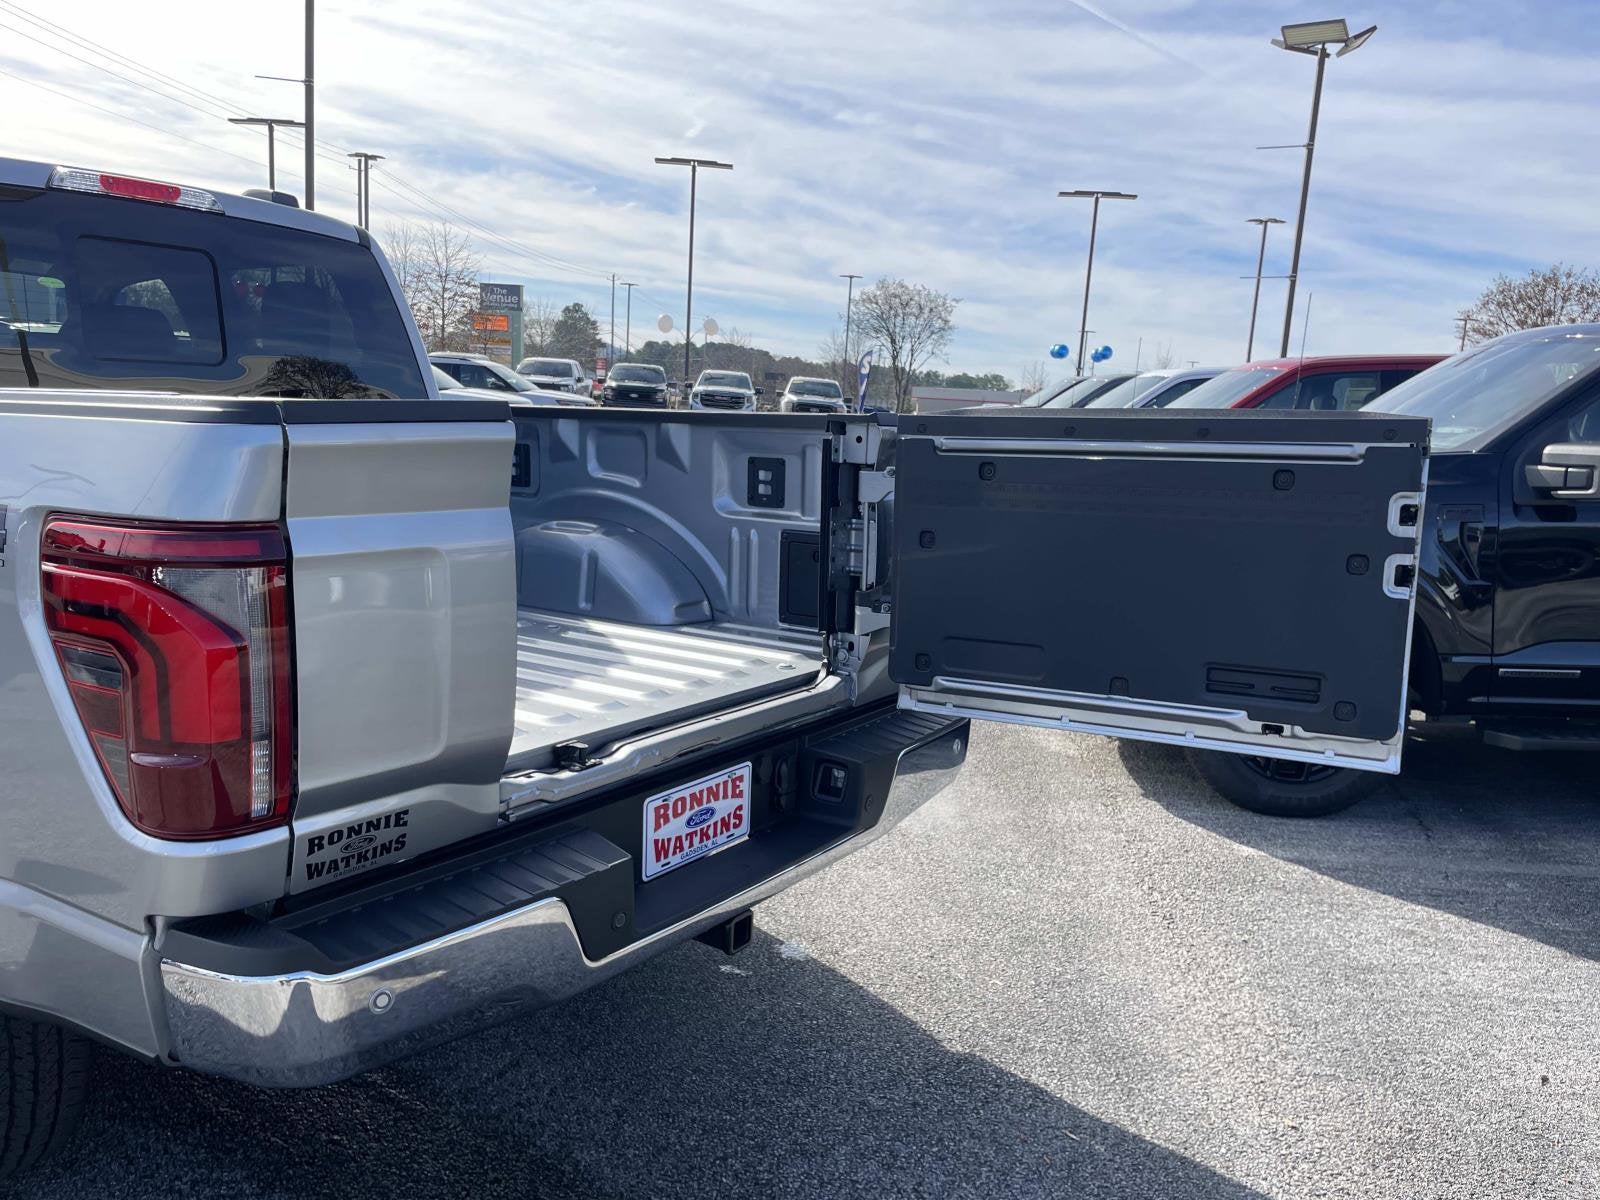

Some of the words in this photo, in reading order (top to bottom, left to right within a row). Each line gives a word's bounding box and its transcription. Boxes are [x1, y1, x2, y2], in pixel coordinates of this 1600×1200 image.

[482, 293, 519, 303] Venue
[493, 287, 508, 295] The
[654, 774, 744, 833] RONNIE
[688, 809, 714, 826] Ford
[306, 833, 406, 880] WATKINS
[307, 809, 409, 857] RONNIE
[653, 804, 743, 863] WATKINS
